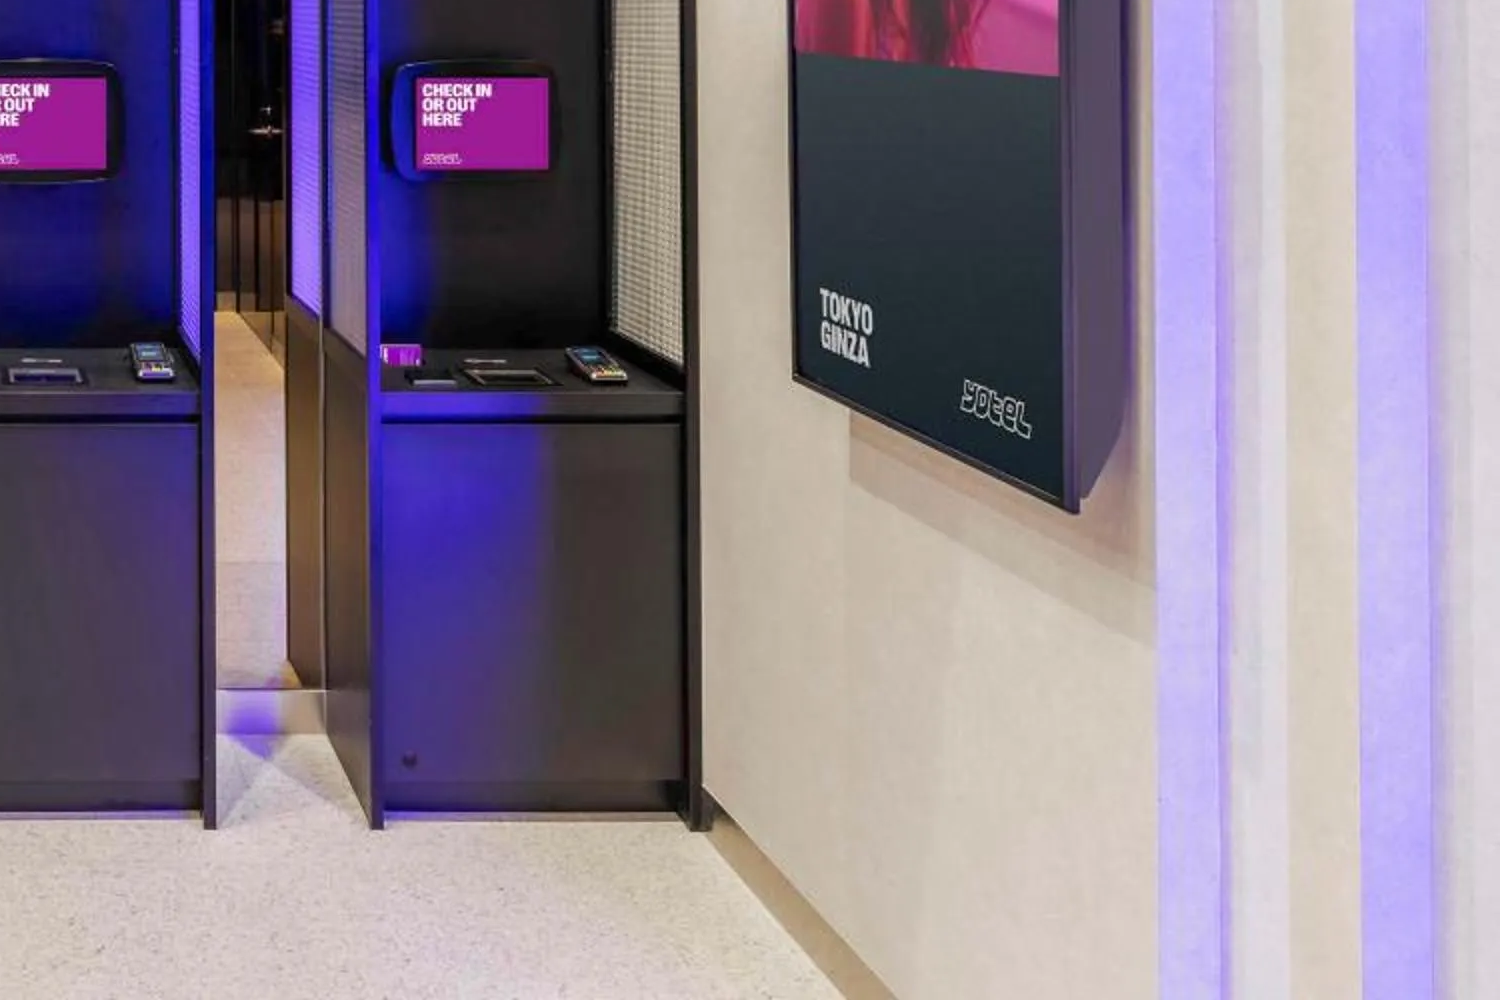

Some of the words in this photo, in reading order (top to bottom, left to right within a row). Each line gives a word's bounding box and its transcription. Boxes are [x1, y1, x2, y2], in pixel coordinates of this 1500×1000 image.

[33, 83, 50, 97] IN
[422, 83, 472, 97] CHECK
[475, 83, 492, 97] IN
[4, 98, 35, 112] OUT
[422, 98, 444, 112] OR
[446, 98, 477, 112] OUT
[422, 113, 462, 127] HERE
[820, 287, 874, 336] TOKYO
[821, 320, 871, 368] GINZA
